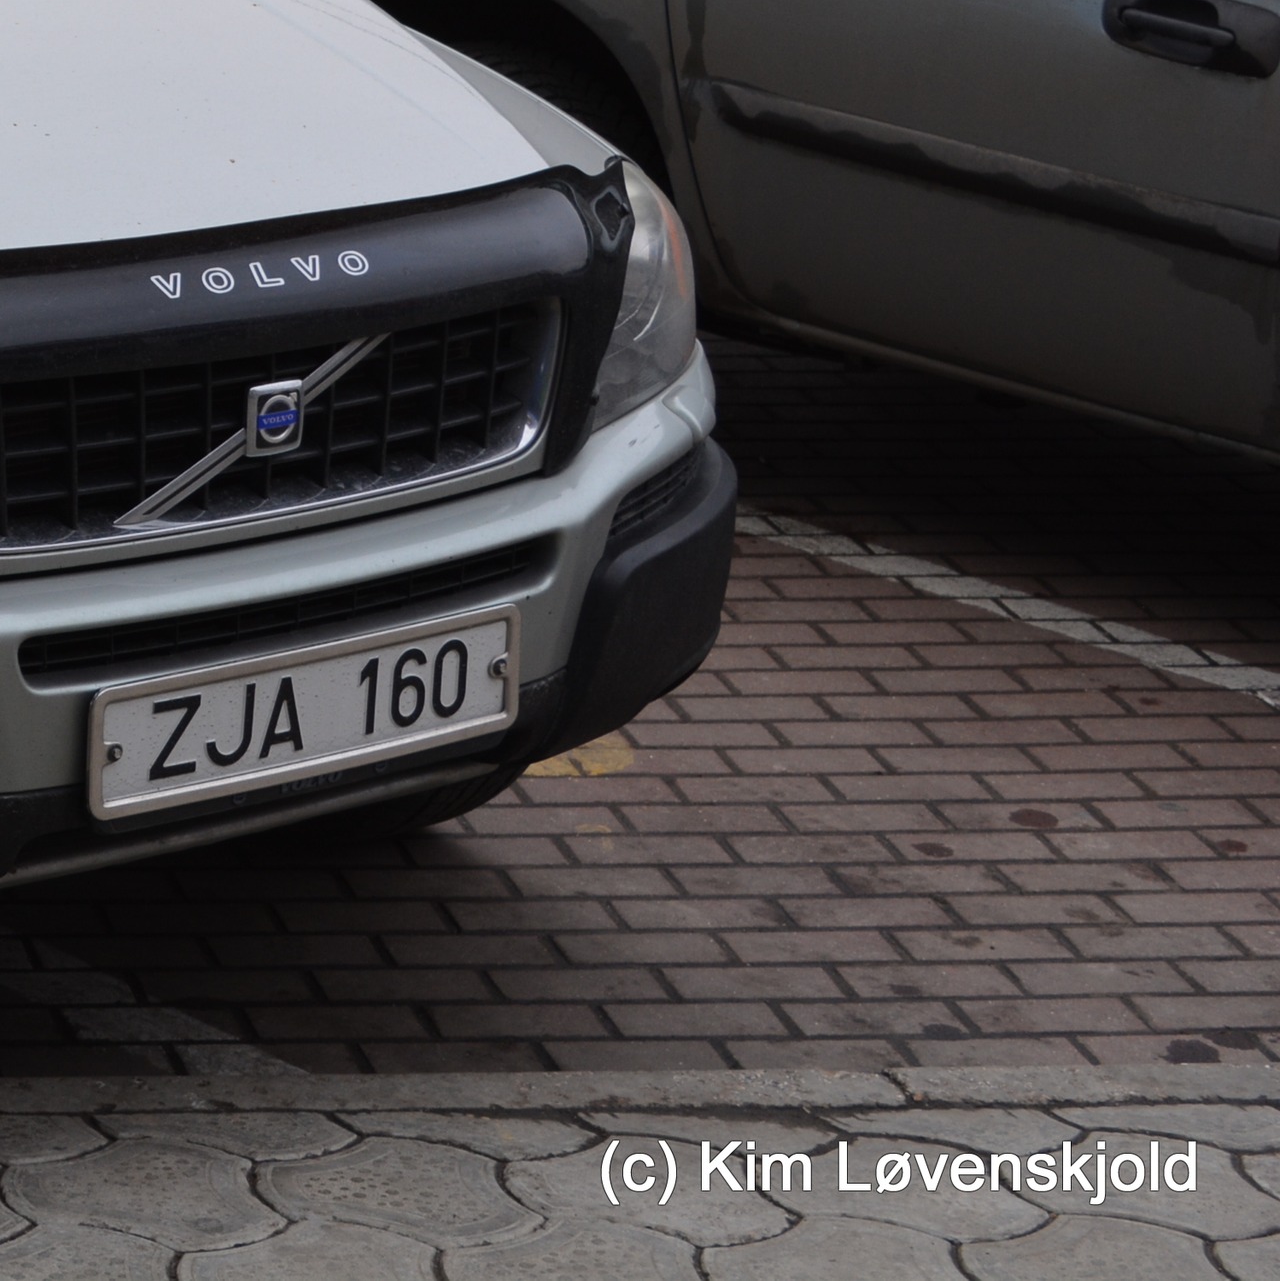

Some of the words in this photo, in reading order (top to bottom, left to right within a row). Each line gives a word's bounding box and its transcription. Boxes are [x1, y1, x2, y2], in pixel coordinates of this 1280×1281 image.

[149, 249, 371, 300] VOLVO
[262, 413, 294, 425] VOLVO
[149, 676, 304, 782] ZJA
[359, 639, 469, 737] 160
